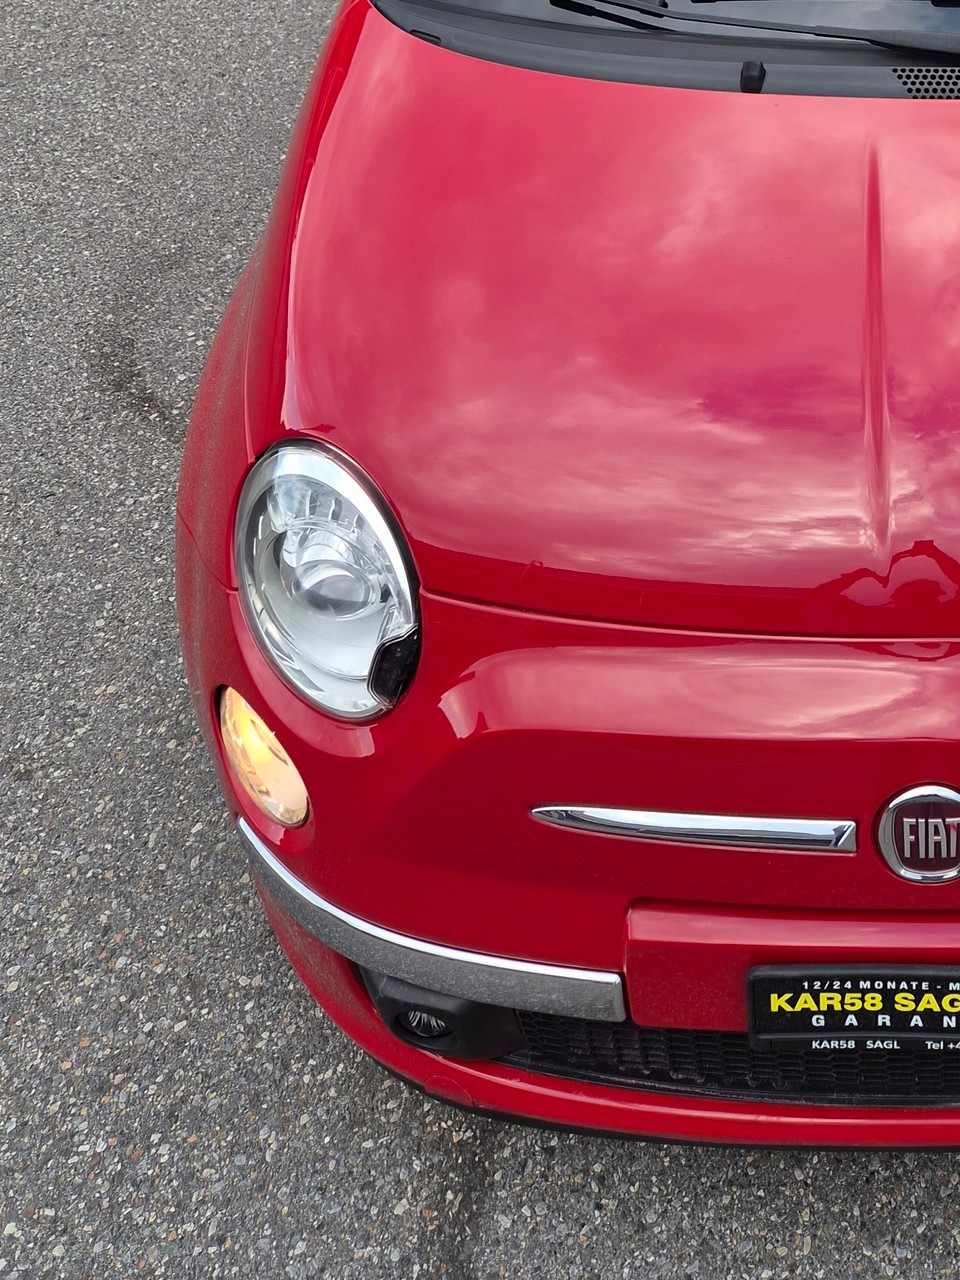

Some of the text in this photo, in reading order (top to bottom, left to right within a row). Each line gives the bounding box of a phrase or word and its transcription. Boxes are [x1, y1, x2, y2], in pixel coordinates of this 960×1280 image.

[802, 980, 852, 990] 12/24
[859, 980, 930, 990] MONATE
[770, 992, 883, 1012] KAR58
[812, 1040, 856, 1049] KAR58
[866, 1040, 901, 1049] SAGL
[925, 1040, 944, 1050] Tel
